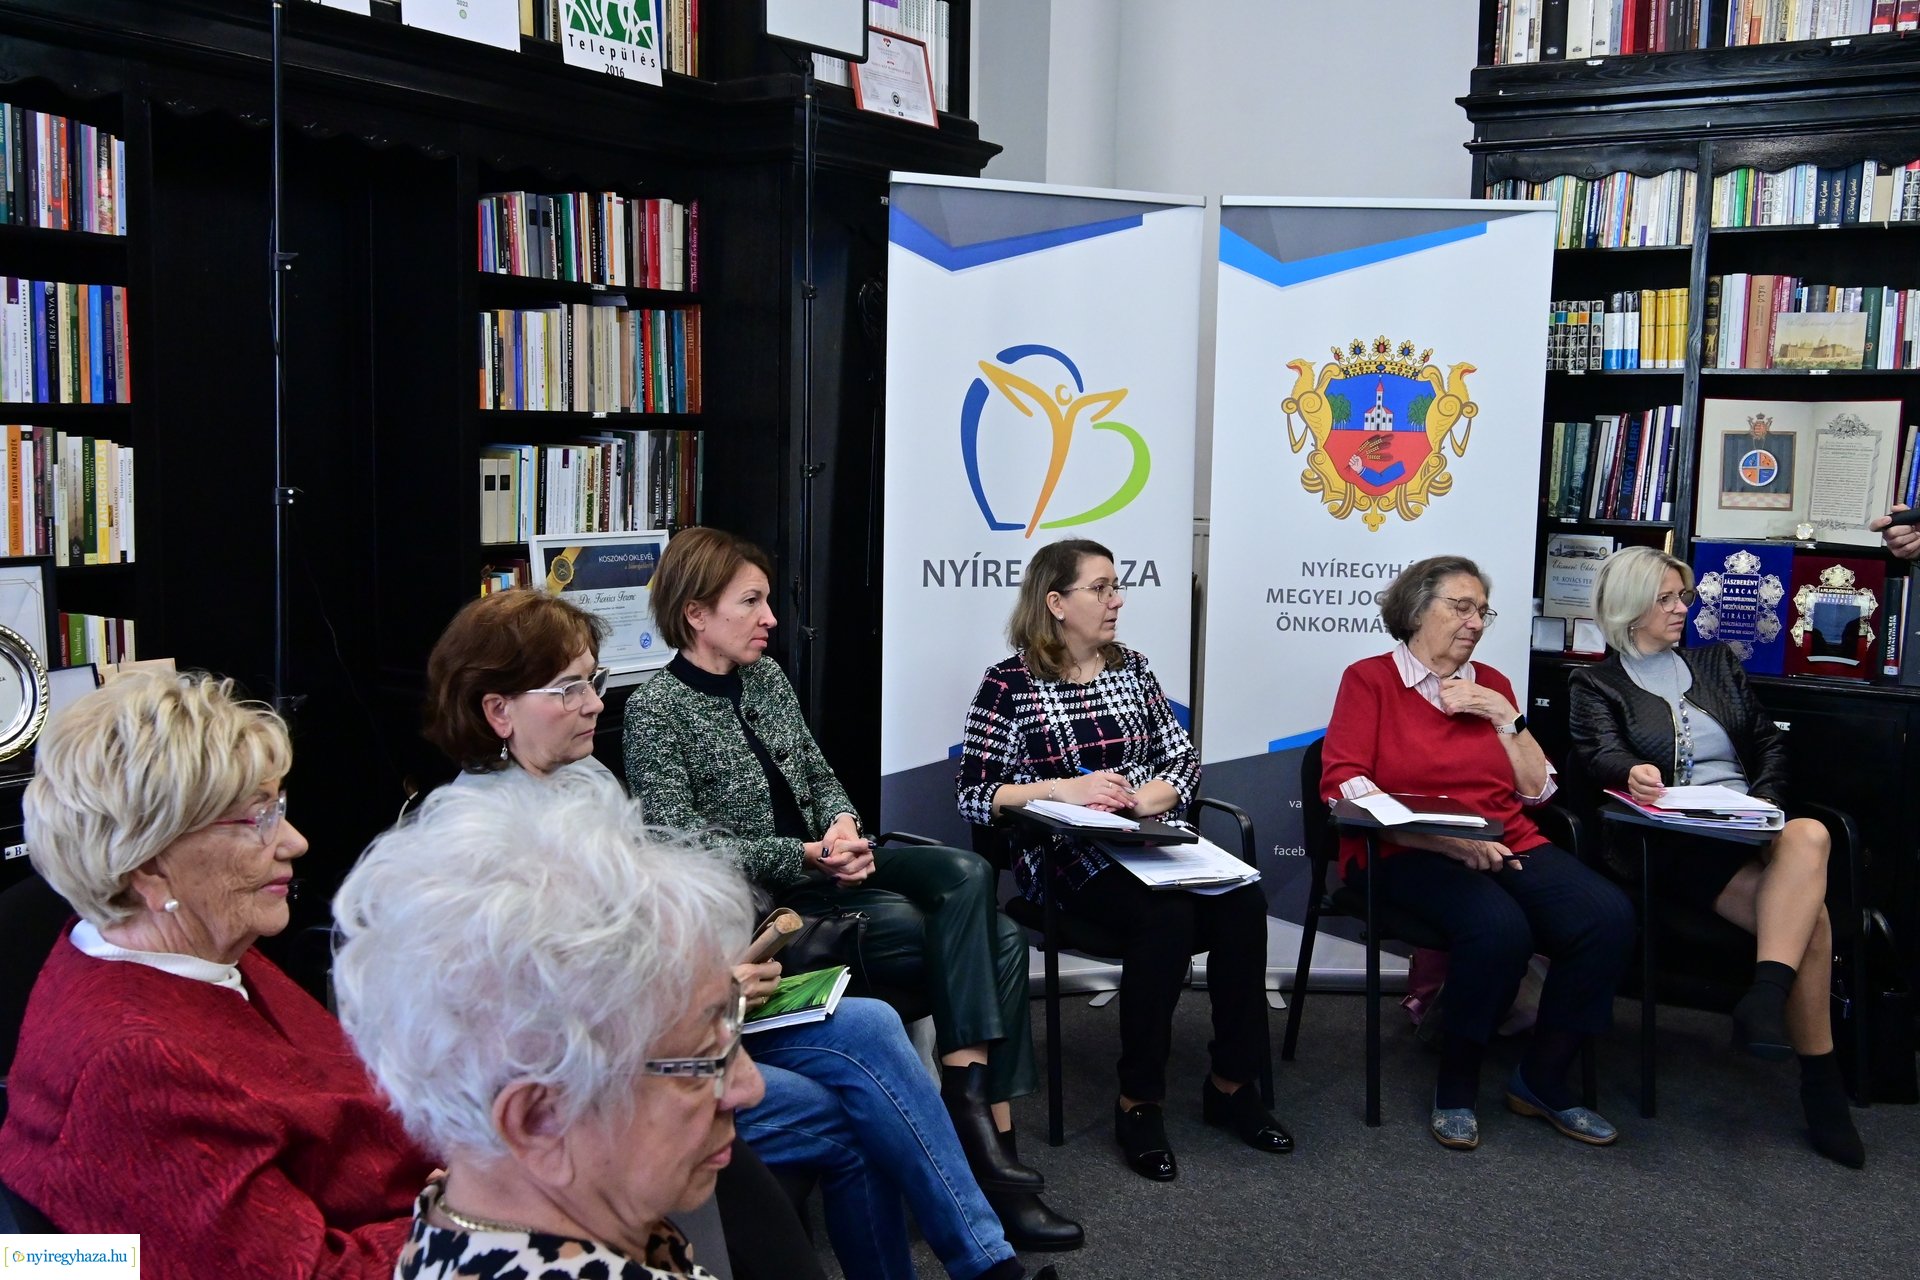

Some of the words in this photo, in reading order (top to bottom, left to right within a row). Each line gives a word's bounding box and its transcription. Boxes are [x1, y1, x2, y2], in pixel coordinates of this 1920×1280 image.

[568, 33, 656, 68] Település
[605, 63, 625, 78] 2016
[47, 297, 56, 321] ANYA
[47, 324, 57, 350] TERÉZ
[1626, 420, 1640, 462] ALBERT
[10, 438, 18, 470] NEMZEDÉK
[10, 471, 18, 499] SIVATAGI
[97, 443, 108, 529] RANGSOROLÁS
[1622, 464, 1634, 495] NAGY
[586, 493, 594, 523] KICSODA
[628, 552, 655, 562] OKLEVÉL
[1301, 558, 1415, 579] NYÍREGYH
[1723, 587, 1758, 595] KARCAG
[1724, 577, 1759, 586] JÁSZBERÉNY
[579, 593, 592, 605] Dr.
[1266, 588, 1342, 605] MEGYEI
[1721, 612, 1756, 620] KIRÁLYI
[1274, 845, 1306, 857] faceb
